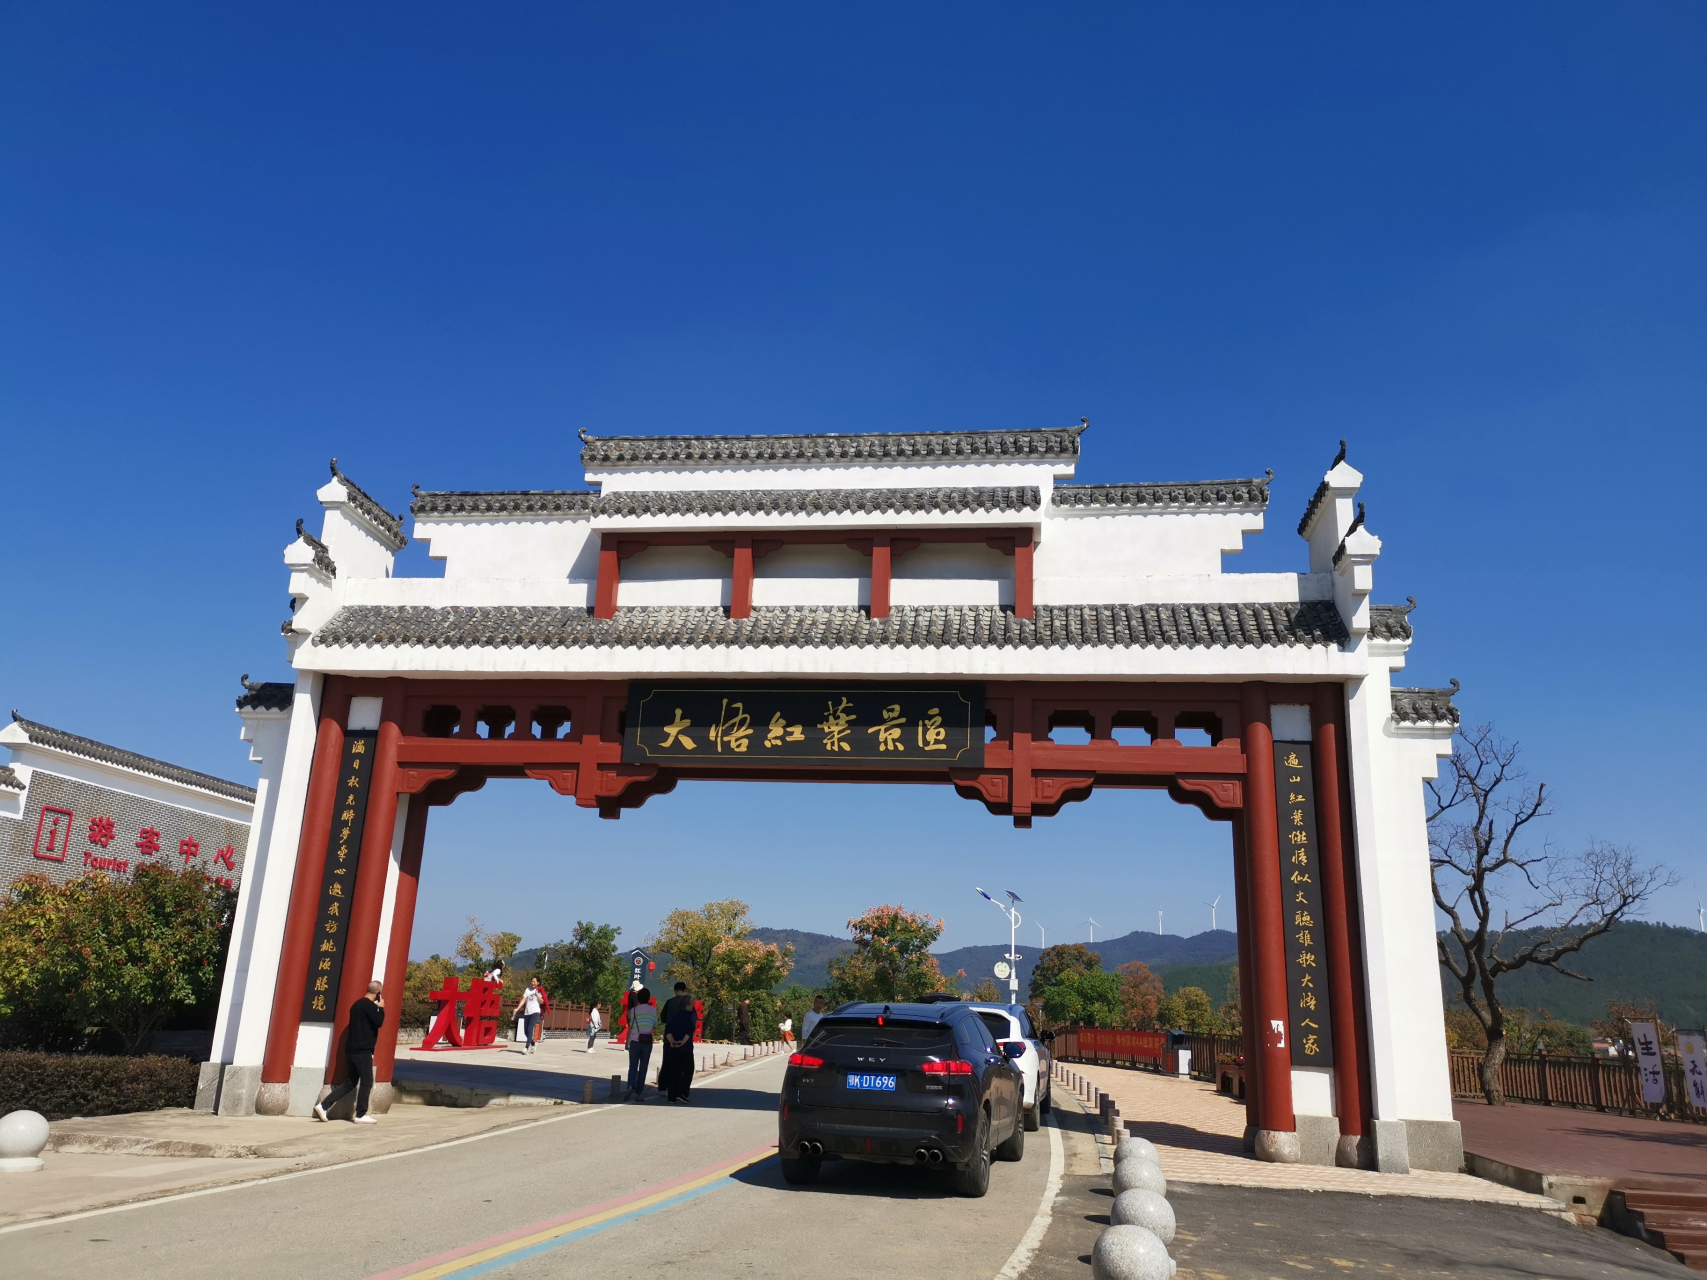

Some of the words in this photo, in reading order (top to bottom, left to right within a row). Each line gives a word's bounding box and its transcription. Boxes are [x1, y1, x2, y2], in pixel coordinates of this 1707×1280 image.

[658, 697, 947, 753] 大悟紅葉景區
[83, 850, 128, 873] Tourist
[88, 816, 236, 871] 游客中心
[1637, 1033, 1660, 1084] 生活
